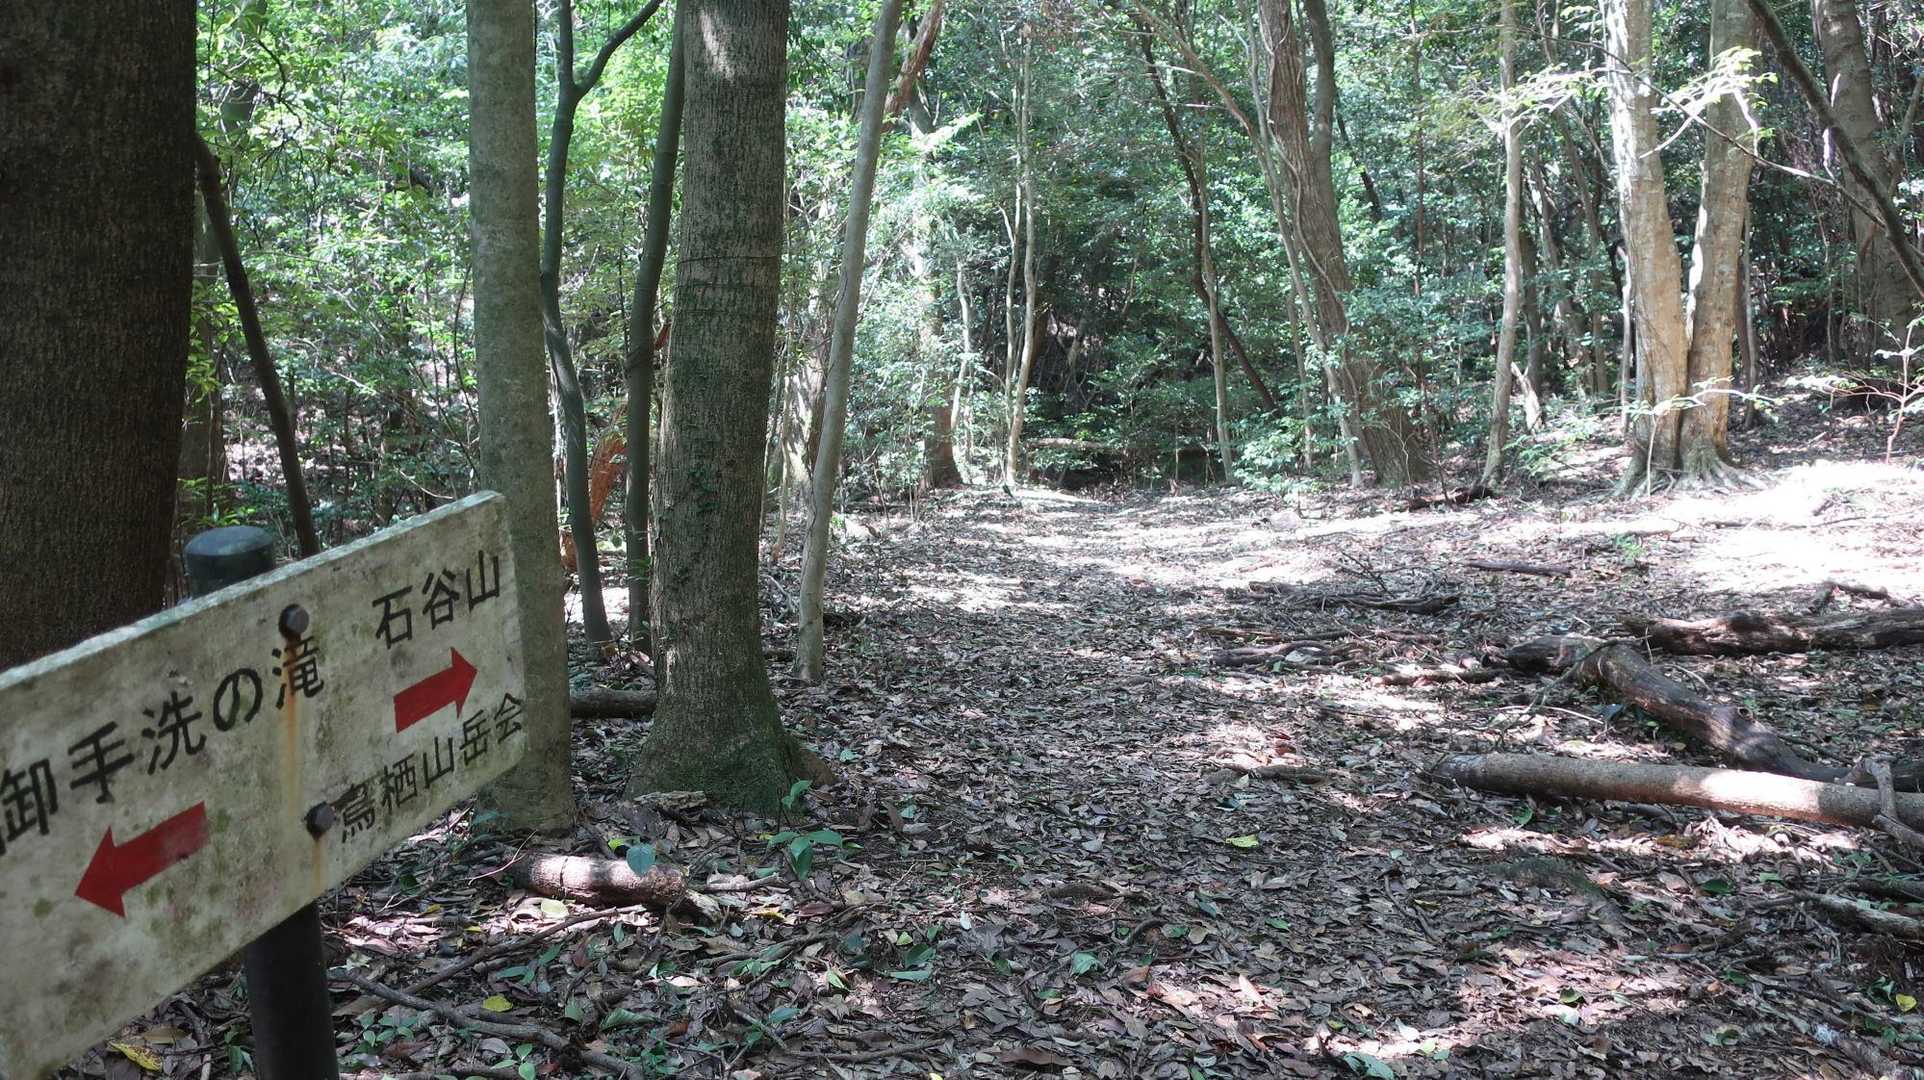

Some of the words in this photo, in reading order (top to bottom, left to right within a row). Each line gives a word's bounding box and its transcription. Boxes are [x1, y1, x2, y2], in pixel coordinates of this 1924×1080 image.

[372, 550, 500, 650] 石谷山
[0, 635, 325, 857] 御手洗の滝
[340, 692, 523, 844] 鳥栖山岳会
